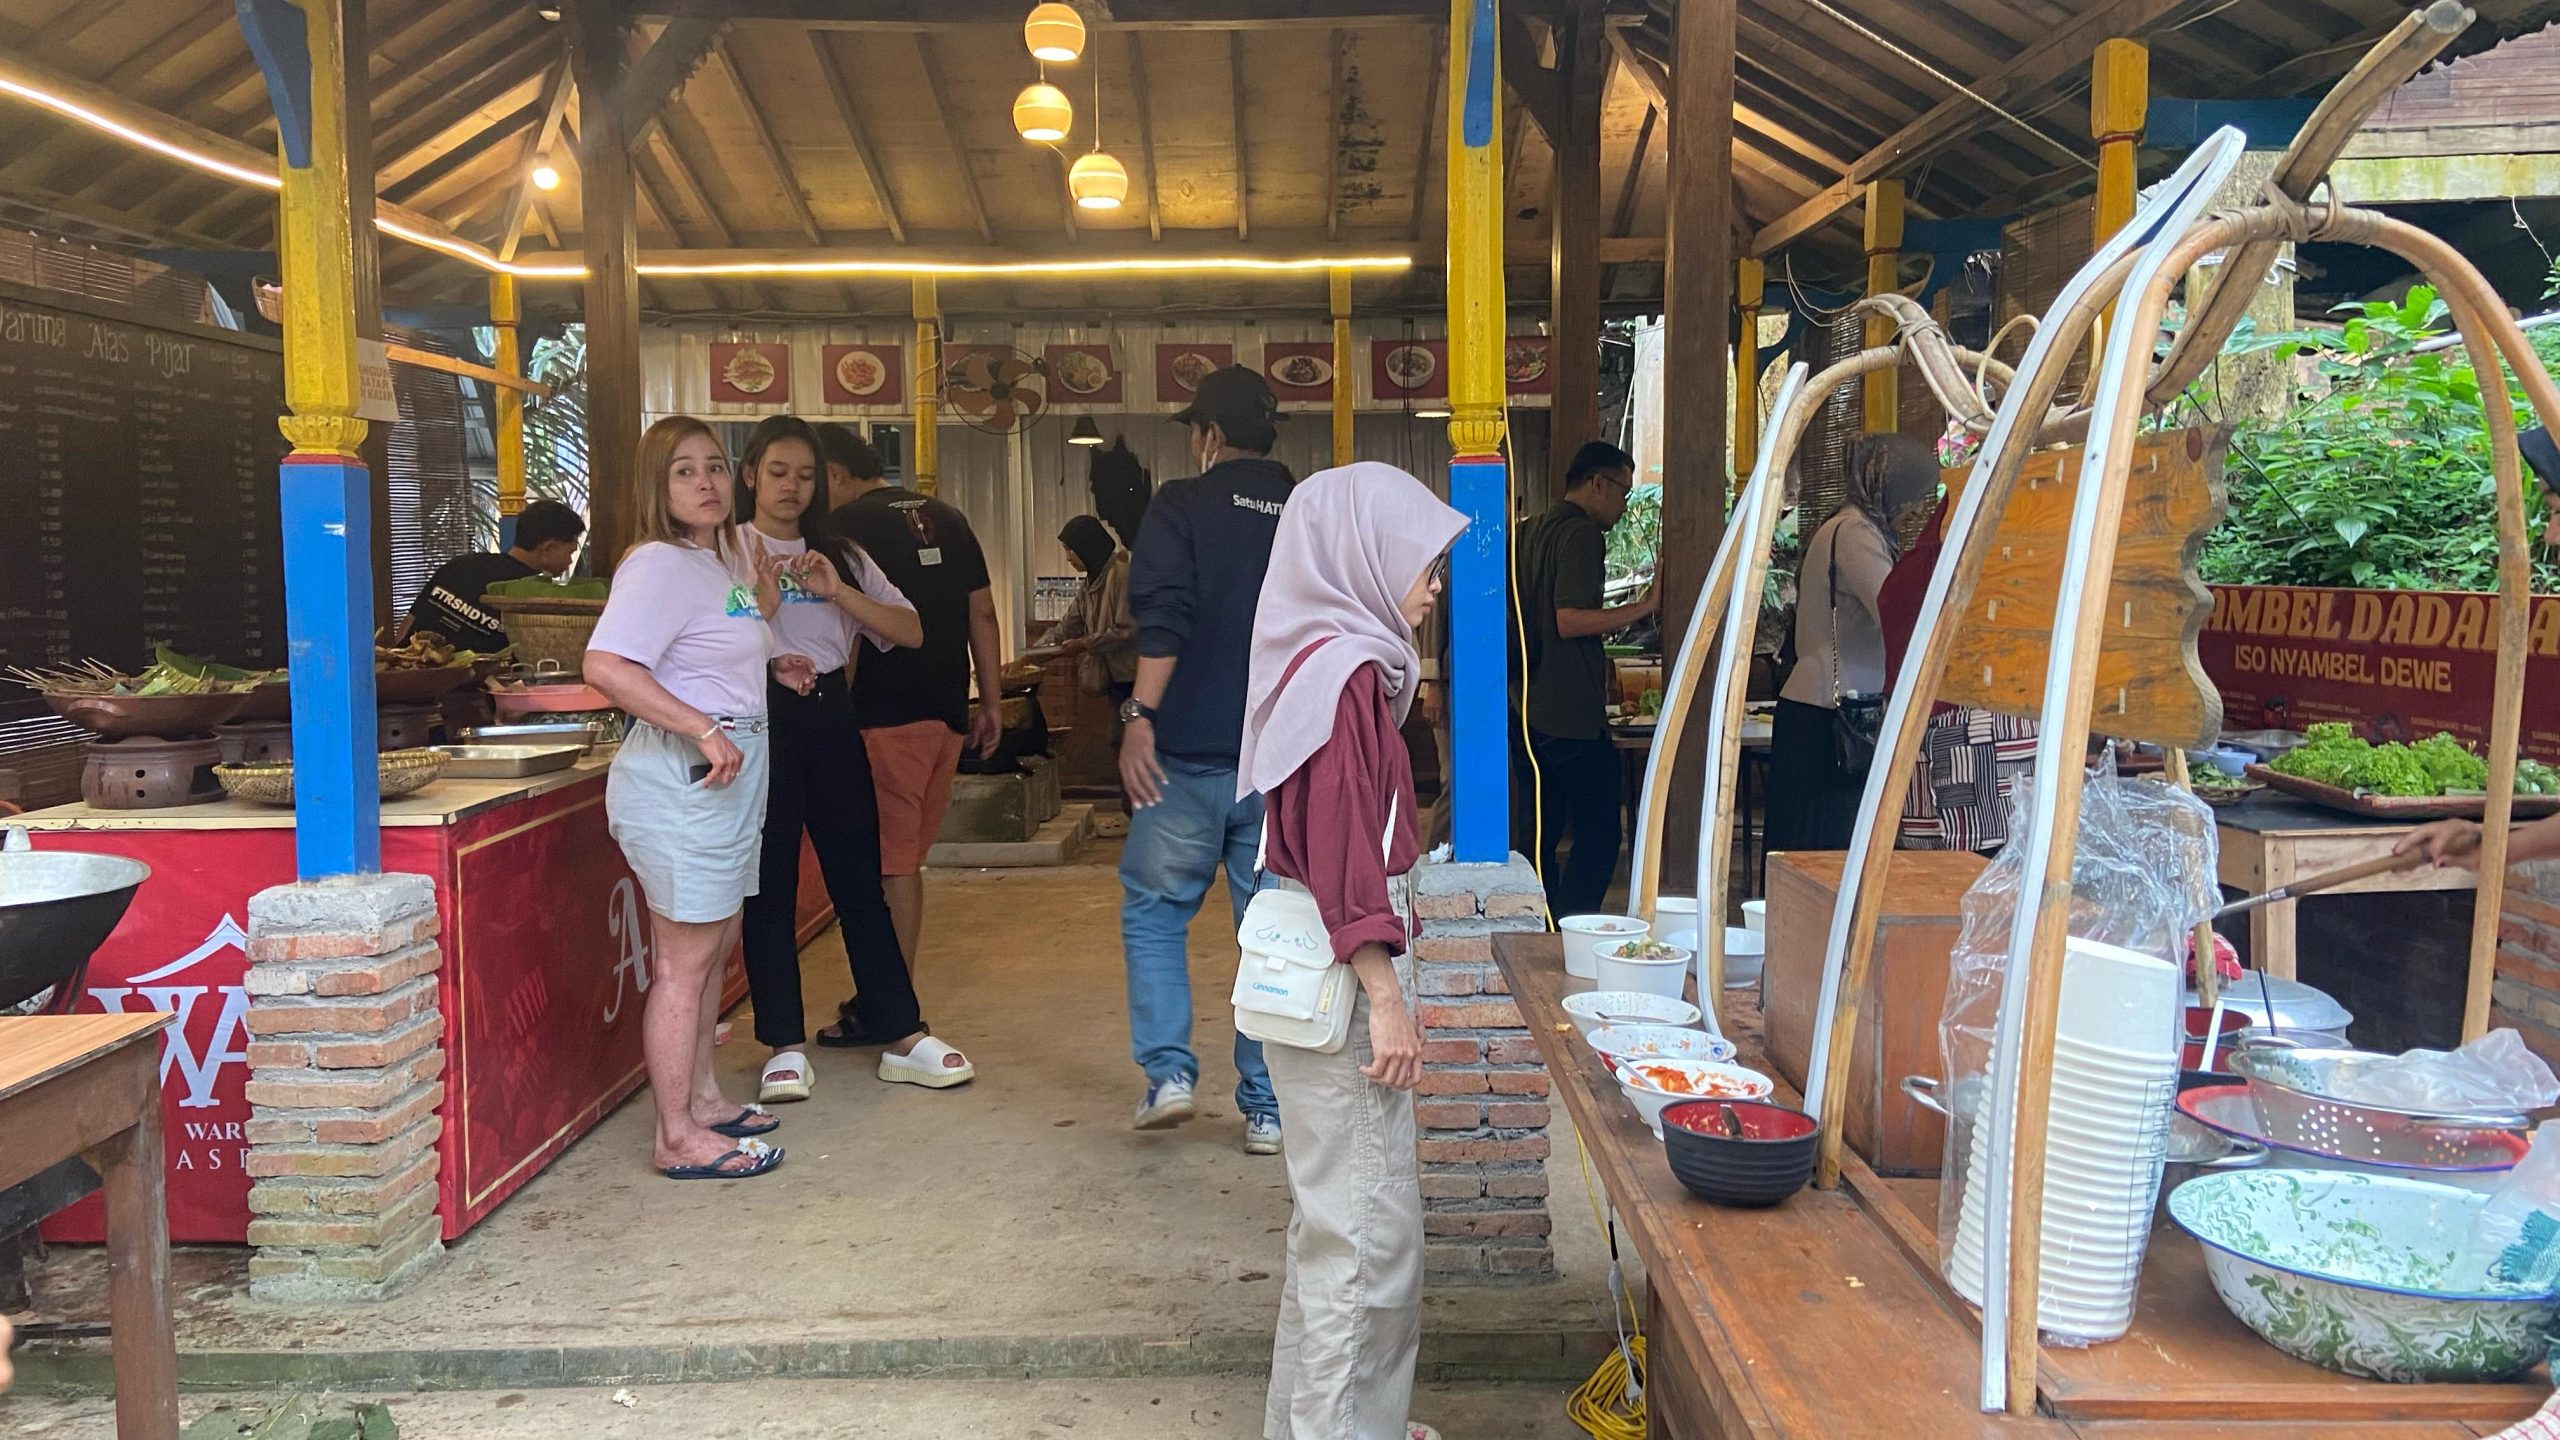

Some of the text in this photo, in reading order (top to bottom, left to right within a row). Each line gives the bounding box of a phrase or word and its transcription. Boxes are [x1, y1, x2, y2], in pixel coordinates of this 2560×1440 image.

[0, 304, 67, 348] arung
[83, 322, 129, 363] Alas
[145, 332, 197, 379] Pijar
[2198, 587, 2342, 639] AMBEL
[2234, 644, 2452, 693] ISO NYAMBEL DEWE
[184, 1122, 243, 1141] WAR
